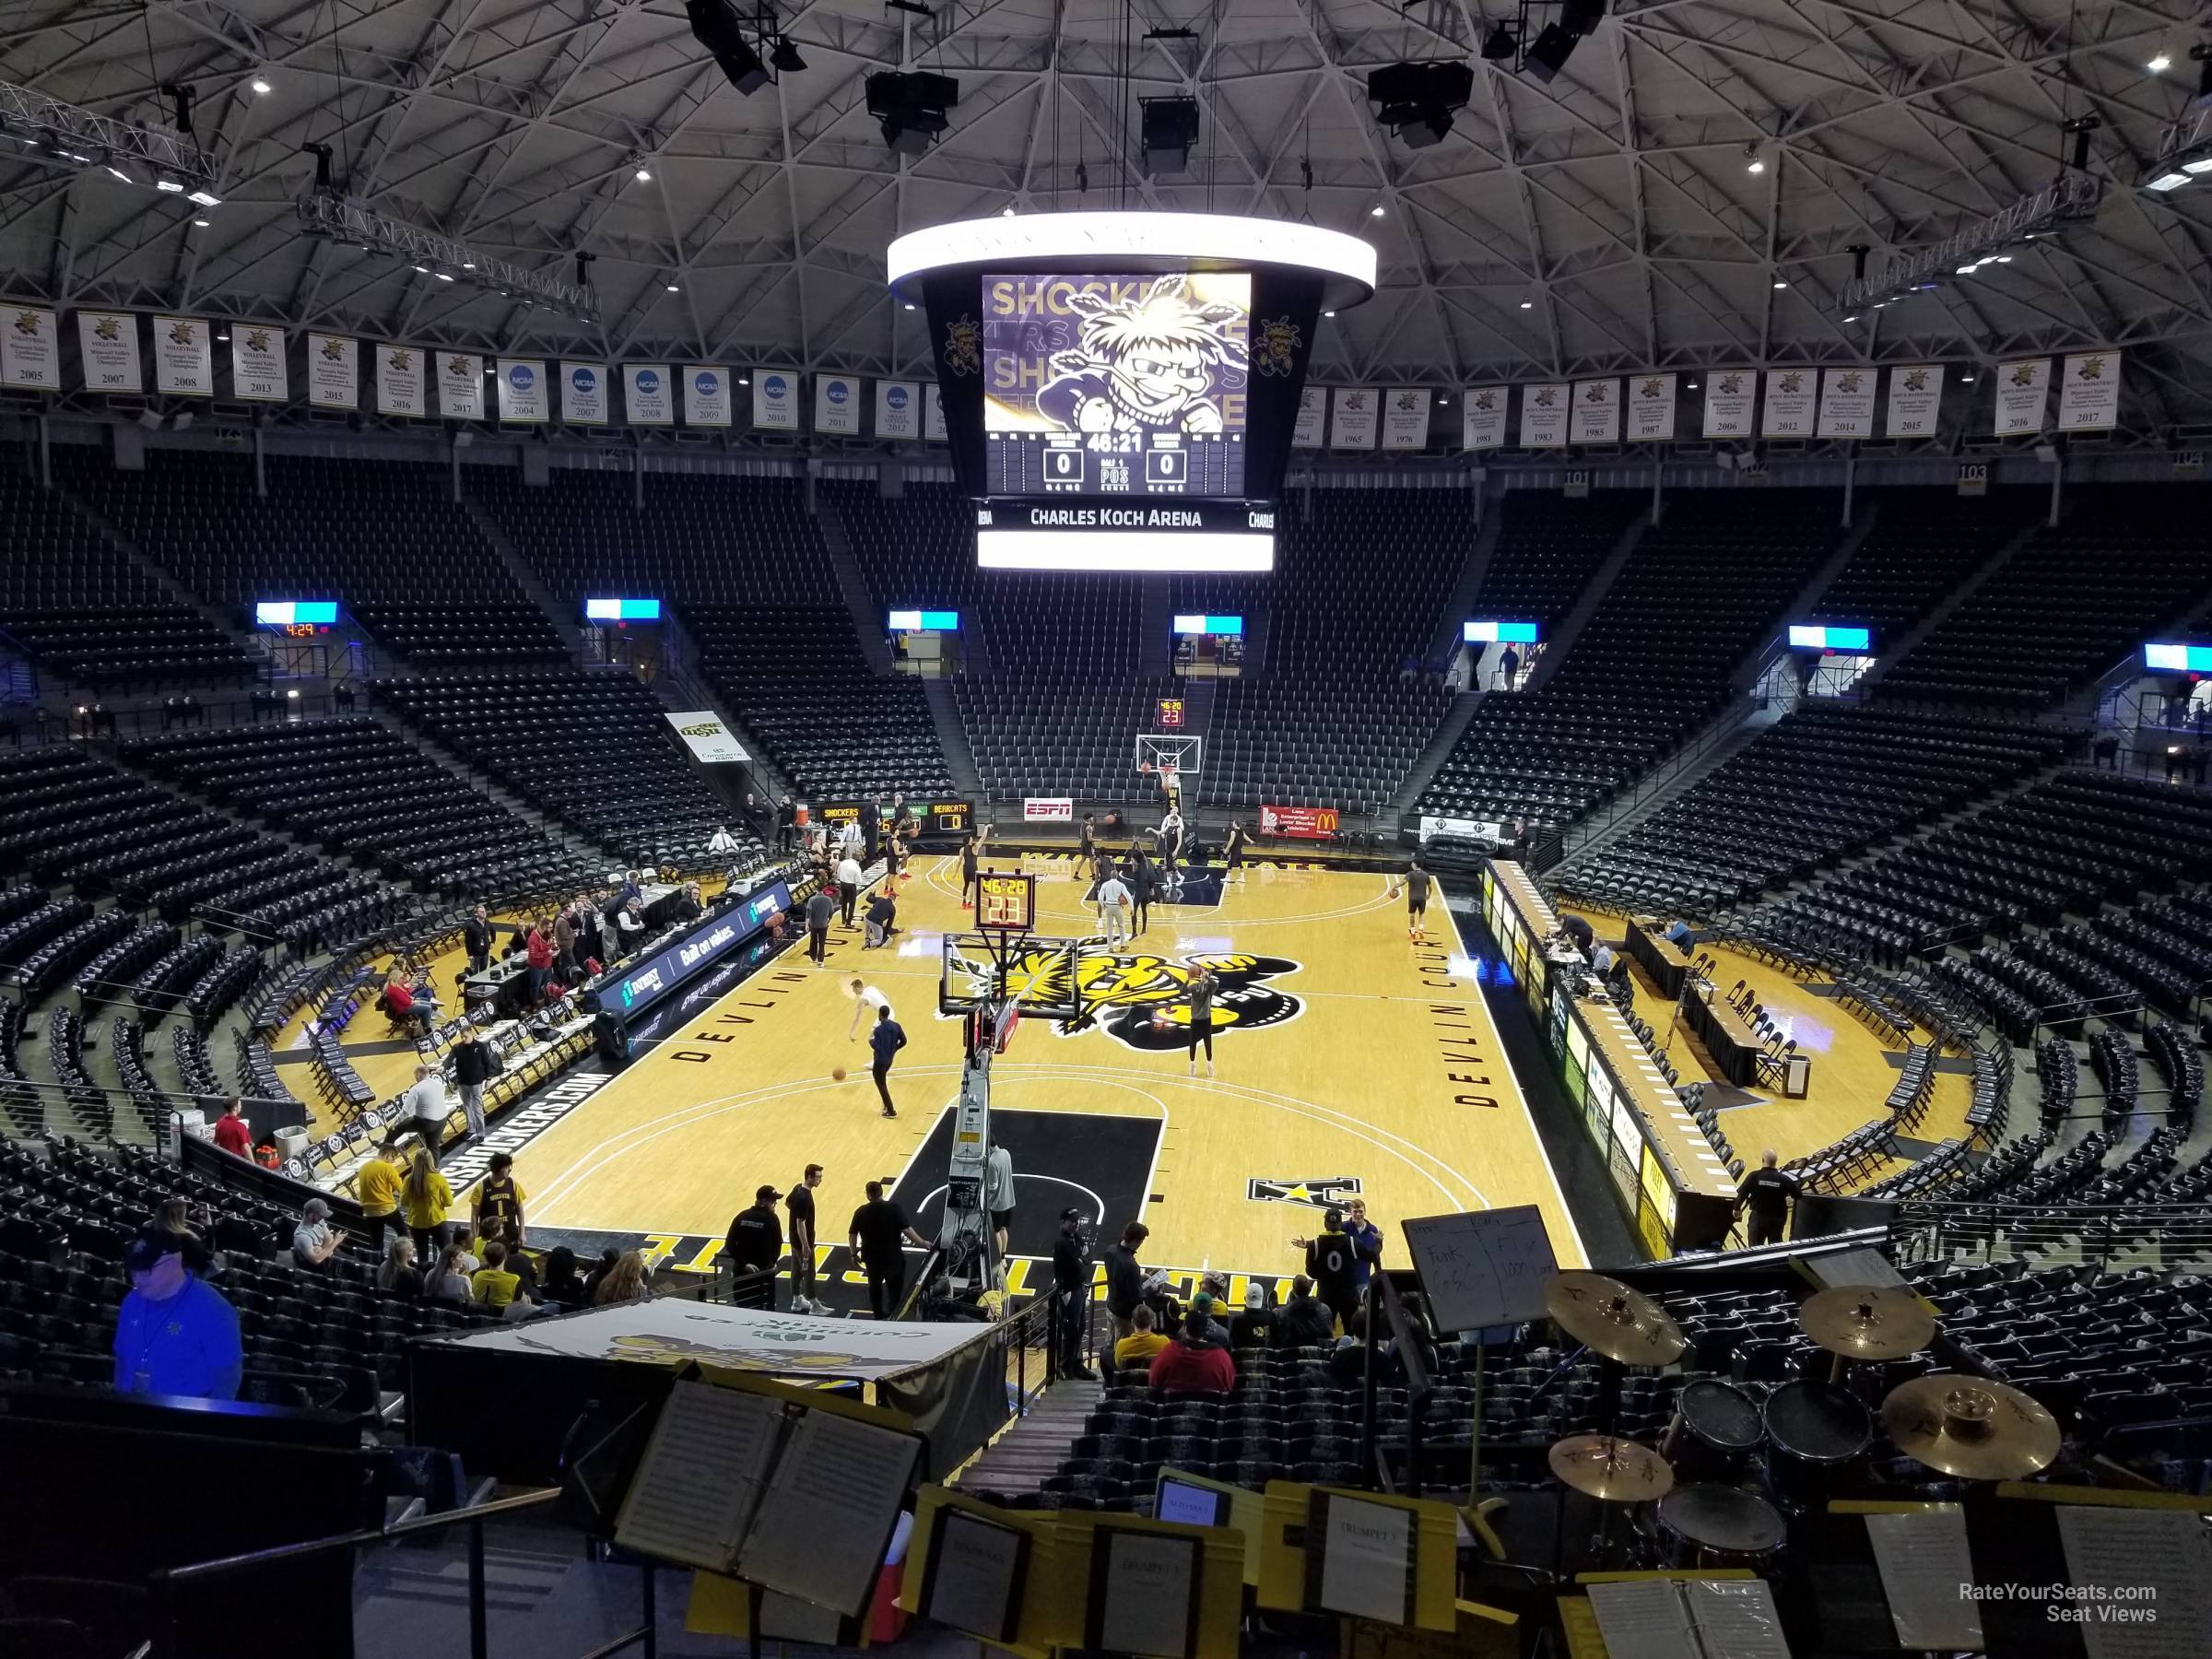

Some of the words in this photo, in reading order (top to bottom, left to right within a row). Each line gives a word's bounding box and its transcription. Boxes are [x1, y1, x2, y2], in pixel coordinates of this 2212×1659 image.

[20, 370, 42, 380] 2005
[103, 374, 124, 383] 2007
[174, 377, 196, 386] 2008
[252, 383, 271, 392] 2013
[324, 391, 343, 400] 2015
[393, 400, 410, 408] 2016
[453, 404, 471, 412] 2017
[576, 408, 595, 418] 2007
[2077, 413, 2099, 422] 2017
[888, 422, 905, 431] 2012
[2009, 418, 2028, 427] 2016
[1088, 434, 1141, 453] 46:21
[1057, 453, 1070, 474] 0
[1160, 454, 1173, 474] 0
[1100, 468, 1128, 484] POS
[1959, 465, 1987, 478] 103
[1565, 472, 1589, 484] 101
[1030, 509, 1096, 525] CHARLES
[1100, 509, 1144, 526] KOCH
[1147, 510, 1202, 526] ARENA
[286, 623, 313, 636] 4:29
[1160, 701, 1182, 710] 46:20
[1163, 711, 1179, 723] 23
[825, 808, 859, 818] SHOCKERS
[935, 805, 967, 813] BEARCATS
[1027, 804, 1070, 815] ESPN
[952, 817, 959, 828] 0
[982, 879, 1026, 894] 46:20
[988, 896, 1019, 922] 23
[679, 945, 699, 966] Built
[700, 938, 712, 954] on
[670, 972, 808, 1063] DEVLIN
[1429, 1005, 1499, 1108] DEVLIN
[440, 1073, 613, 1194] OSHOCKERS.COM
[1327, 1251, 1342, 1272] 0
[1342, 1522, 1386, 1540] TRUMPET
[1123, 1561, 1172, 1572] TRUMPET
